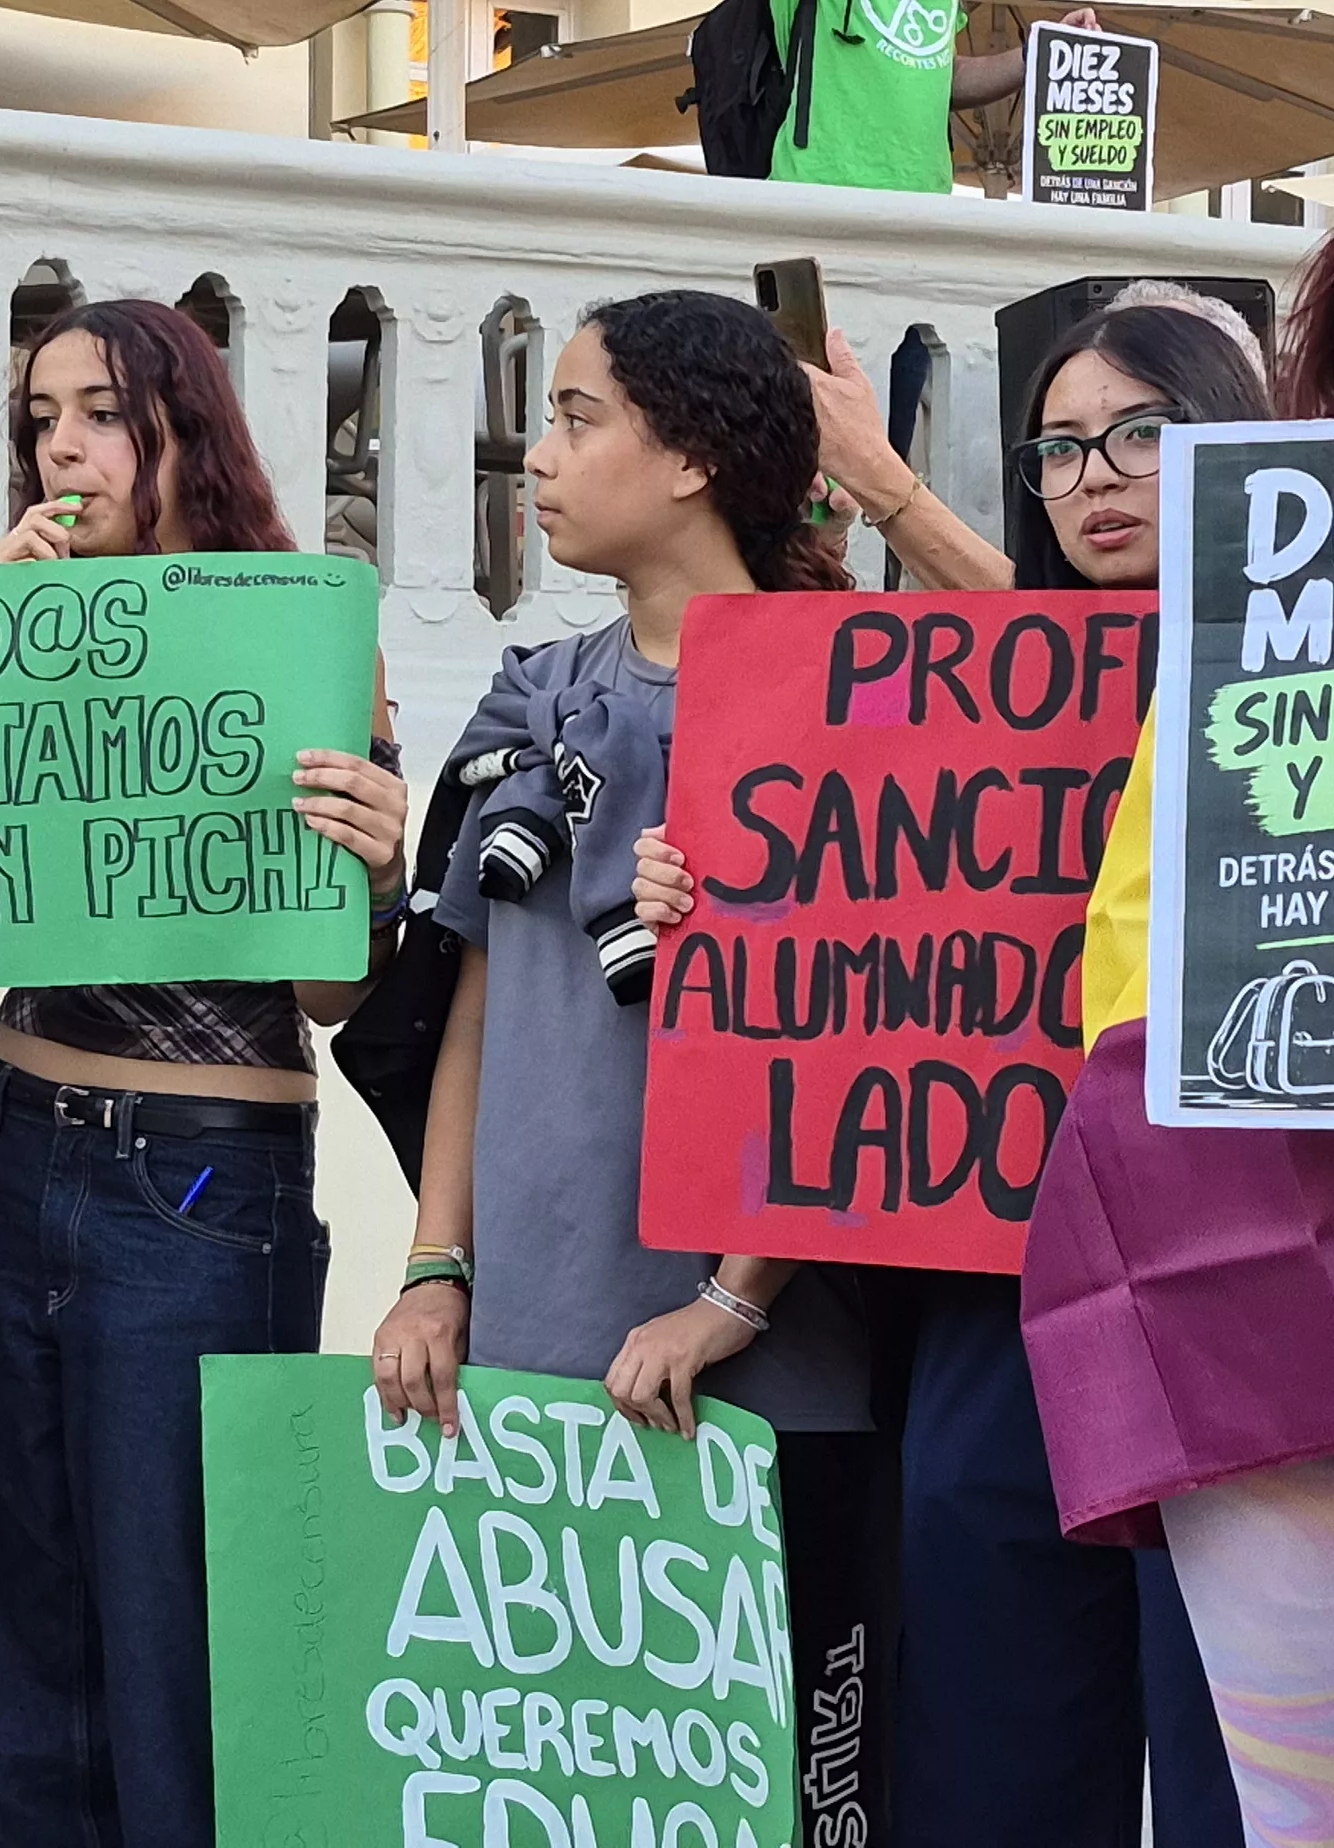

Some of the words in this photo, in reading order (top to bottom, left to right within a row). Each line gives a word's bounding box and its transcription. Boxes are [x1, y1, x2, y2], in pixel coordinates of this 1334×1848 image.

[1048, 40, 1121, 81] DIEZ
[1046, 81, 1135, 114] MESES
[1045, 119, 1070, 141] SIN
[1075, 119, 1136, 140] EMPLEO
[1058, 145, 1068, 165] Y
[1071, 145, 1127, 165] SUELDO
[1051, 190, 1068, 203] HAY
[1233, 685, 1333, 755] SIN
[1286, 755, 1322, 819] Y
[84, 808, 346, 919] PICHI
[1260, 894, 1330, 929] HAY
[767, 1057, 1068, 1222] LADO
[363, 1384, 660, 1519] BASTA
[695, 1422, 779, 1552] DE
[366, 1679, 768, 1808] QUEREMOS
